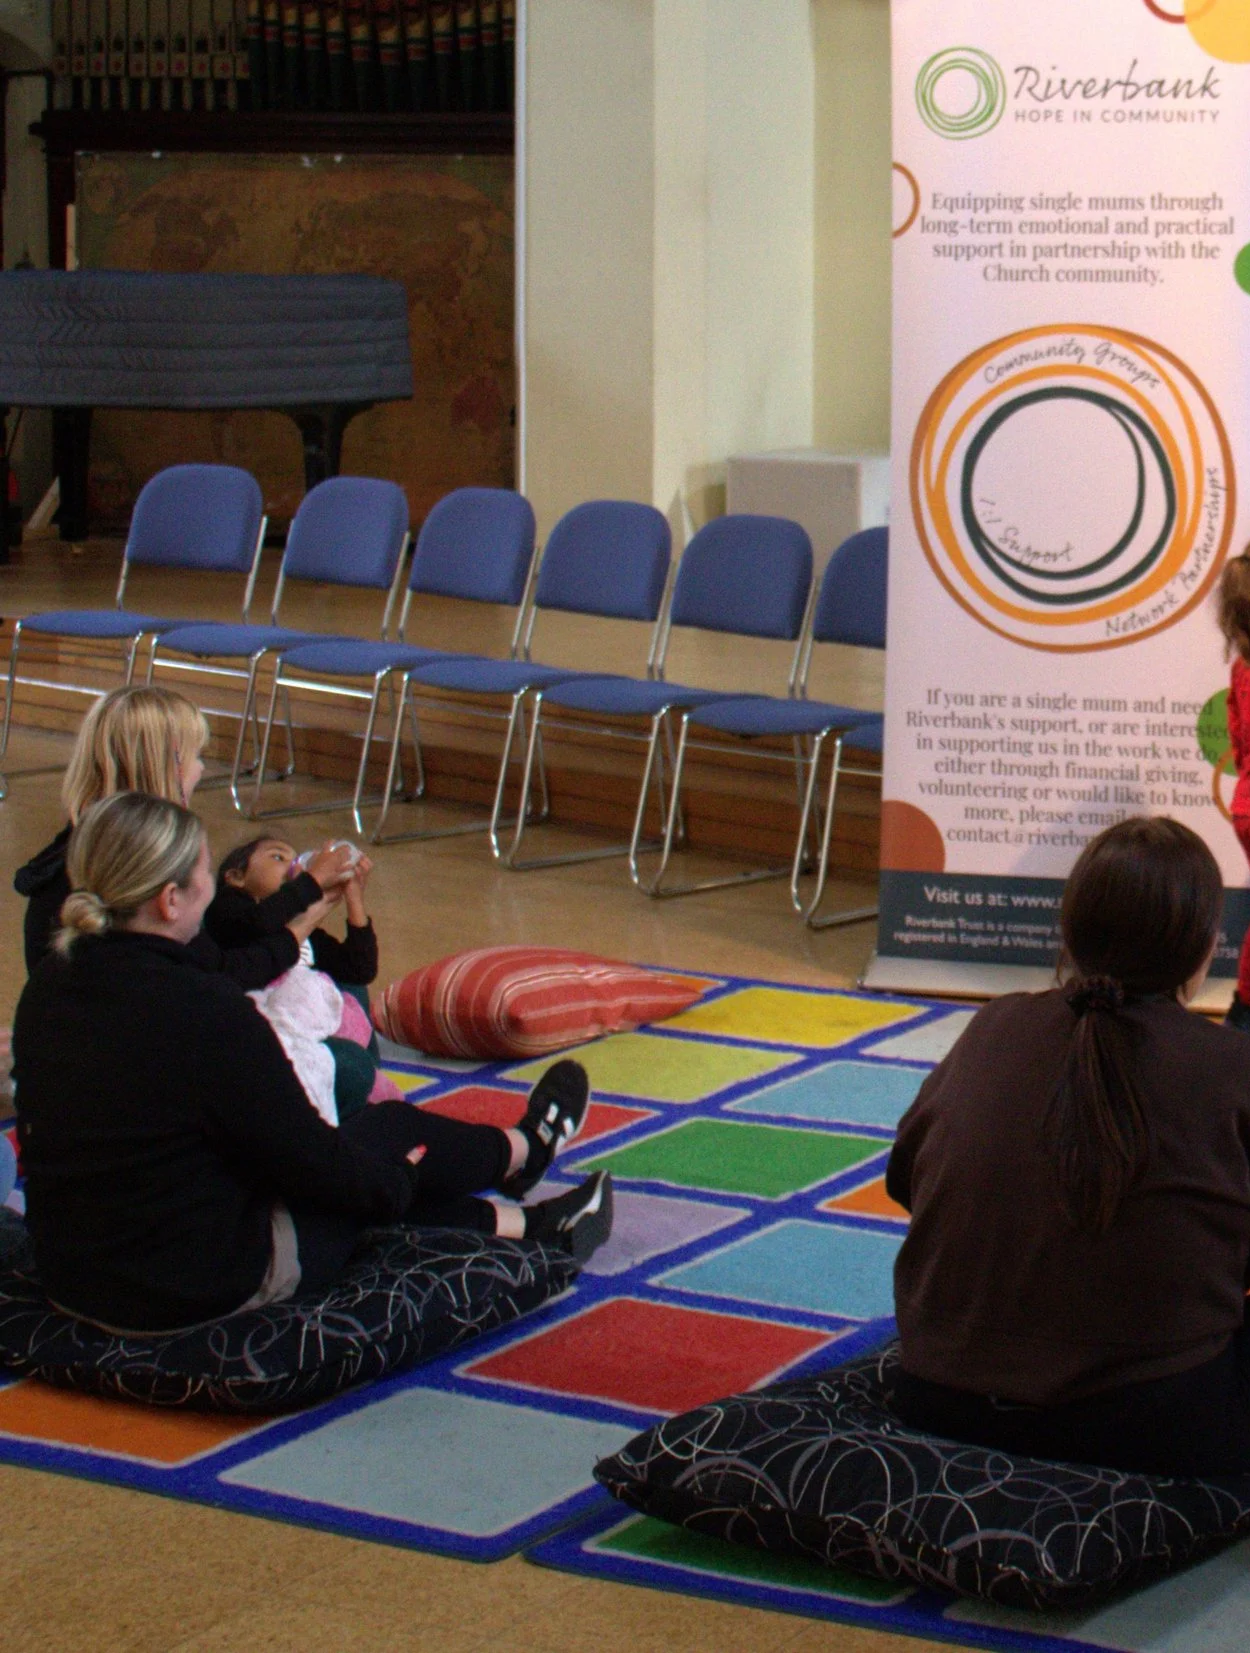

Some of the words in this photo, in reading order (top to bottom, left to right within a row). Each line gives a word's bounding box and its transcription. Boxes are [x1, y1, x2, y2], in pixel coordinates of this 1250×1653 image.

[1013, 58, 1221, 103] Riverbank
[1014, 109, 1064, 124] HOPE
[1073, 109, 1093, 124] IN
[1100, 109, 1220, 124] COMMUNITY
[930, 192, 1024, 215] Equipping
[1030, 193, 1083, 214] single
[1088, 196, 1145, 212] mums
[1150, 193, 1223, 214] through
[920, 217, 1013, 237] long-term
[1018, 217, 1109, 235] emotional
[1114, 217, 1149, 235] and
[1154, 217, 1234, 238] practical
[932, 242, 1004, 261] support
[1009, 241, 1027, 259] in
[1032, 240, 1141, 262] partnership
[1146, 241, 1185, 259] with
[1190, 241, 1221, 259] the
[982, 264, 1050, 283] Church
[1055, 266, 1165, 287] community.
[983, 338, 1086, 384] Community
[1093, 341, 1161, 390] Groups
[998, 526, 1075, 566] Support
[1104, 590, 1181, 637] Network
[1176, 467, 1228, 589] Partnerships
[926, 688, 941, 705] If
[943, 692, 976, 711] you
[980, 694, 1007, 709] are
[1011, 695, 1022, 709] a
[1026, 692, 1077, 714] single
[1082, 697, 1128, 712] mum
[1133, 696, 1166, 714] and
[1171, 698, 1214, 716] need
[906, 711, 1006, 730] Riverbank's
[1010, 717, 1084, 736] support,
[1088, 721, 1107, 736] or
[1111, 722, 1140, 737] are
[1144, 722, 1231, 740] intereste
[916, 733, 933, 750] in
[938, 736, 1035, 757] supporting
[1038, 739, 1058, 755] us
[1062, 738, 1080, 755] in
[1085, 740, 1113, 757] the
[1117, 741, 1161, 760] work
[1165, 746, 1192, 761] we
[1195, 744, 1218, 762] do
[934, 758, 987, 776] either
[991, 759, 1060, 781] through
[1065, 761, 1141, 782] financial
[1145, 766, 1204, 788] giving,
[918, 778, 1029, 802] volunteering
[1032, 785, 1053, 801] or
[1056, 784, 1110, 803] would
[1113, 784, 1145, 803] like
[1149, 788, 1168, 805] to
[1171, 788, 1218, 807] know
[963, 806, 1014, 823] more,
[1018, 807, 1074, 828] please
[1077, 808, 1126, 826] email
[924, 885, 961, 905] Visit
[965, 892, 984, 906] us
[987, 892, 1008, 907] at:
[904, 915, 956, 930] Riverbank
[957, 917, 985, 931] Trust
[1006, 922, 1053, 937] company
[892, 932, 946, 945] registered
[959, 933, 999, 948] England
[1012, 936, 1045, 949] Wales
